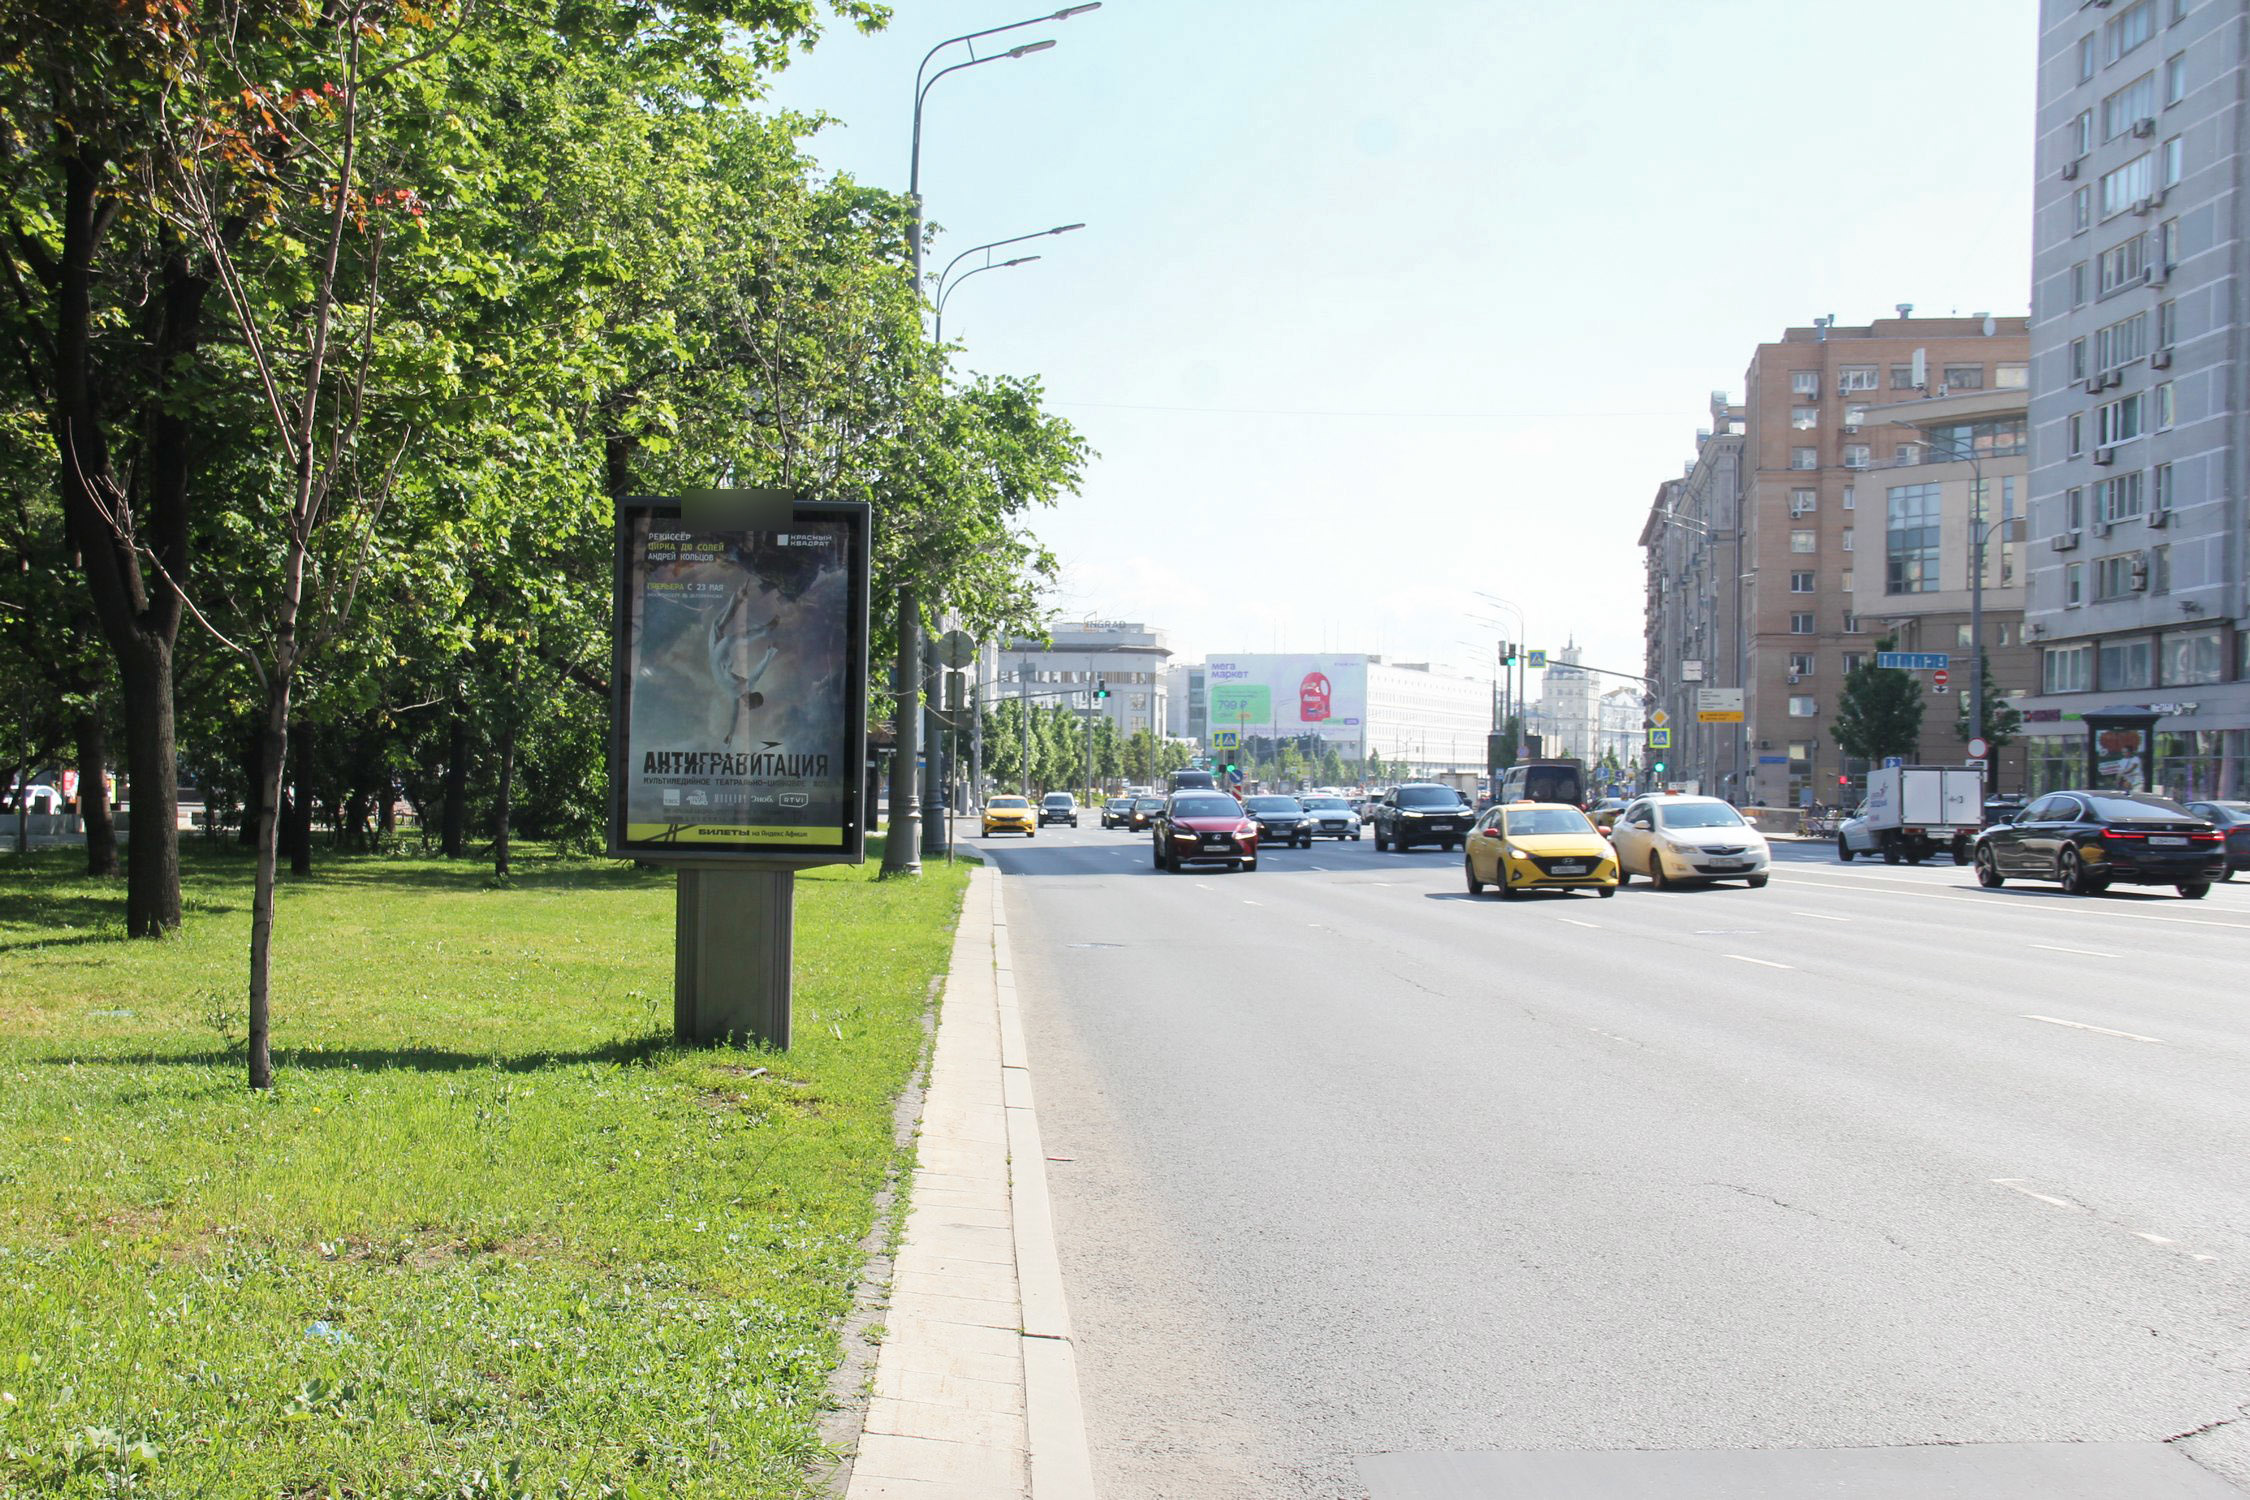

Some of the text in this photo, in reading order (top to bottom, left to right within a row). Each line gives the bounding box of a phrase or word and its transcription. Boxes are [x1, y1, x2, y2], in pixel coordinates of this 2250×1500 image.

[648, 531, 692, 541] РЕЖИССЁР
[647, 542, 725, 552] ЦИРКА ДЮ СОЛЕЙ
[647, 552, 714, 562] АНДРЕЙ КОЛЬЦОВ
[696, 583, 706, 591] 23
[709, 583, 724, 592] МАЯ
[1211, 663, 1236, 671] мега
[1211, 671, 1249, 680] маркет
[1217, 700, 1237, 710] 799
[644, 751, 829, 778] АНТИГРАВИТАЦИЯ
[643, 776, 711, 786] МУЛЬТИМЕДИЙНОЕ
[698, 828, 750, 836] БИЛЕТЫ
